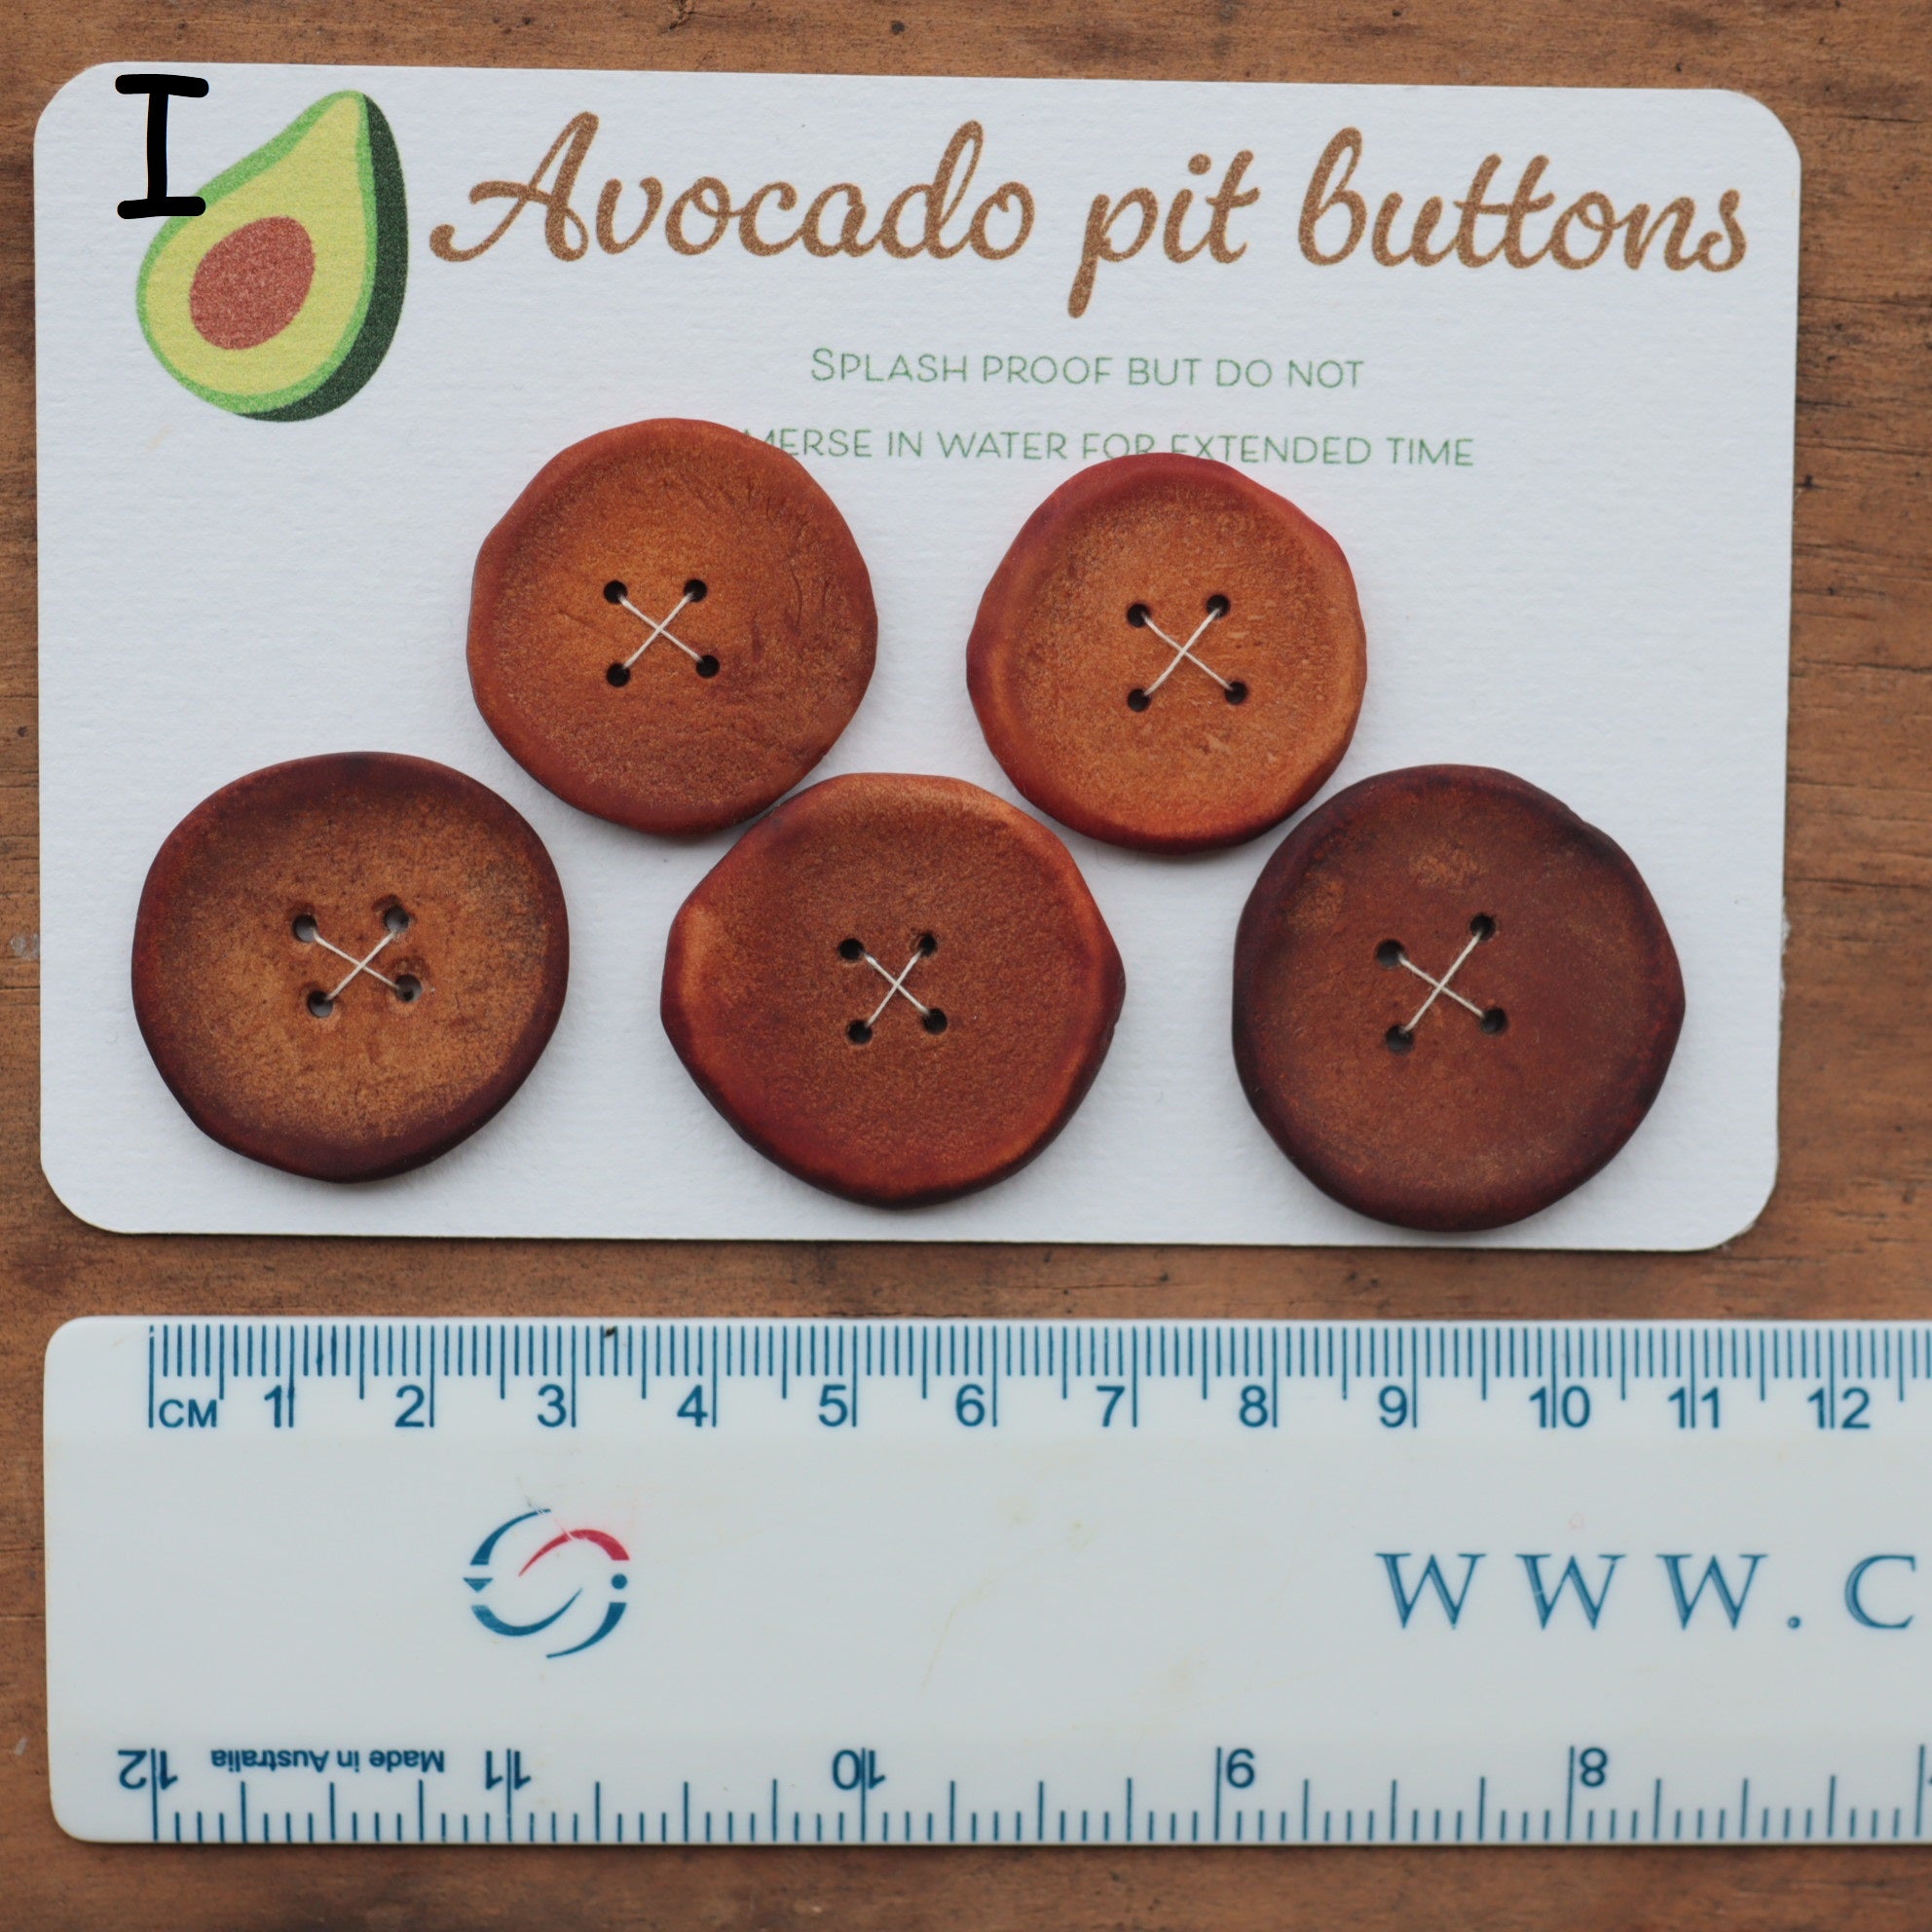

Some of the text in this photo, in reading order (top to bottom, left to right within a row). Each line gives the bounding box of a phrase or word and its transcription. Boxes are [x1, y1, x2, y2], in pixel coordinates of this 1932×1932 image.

[428, 110, 1747, 319] Avocado pit buttons
[810, 347, 1364, 389] SPLASH PROOF BUT DO NOT
[887, 430, 923, 458] IN
[936, 431, 1067, 461] WATER
[1082, 432, 1155, 459] FOR
[1170, 433, 1371, 465] EXTENDED
[1386, 437, 1474, 466] TIME
[158, 1385, 1872, 1430] CM 1 2 3 4 5 6 7 8 9 10 11 12
[116, 1749, 179, 1792] 12
[209, 1748, 446, 1774] Made in Australia
[484, 1749, 533, 1792] 11
[831, 1749, 887, 1790] 10
[1577, 1746, 1610, 1789] 8
